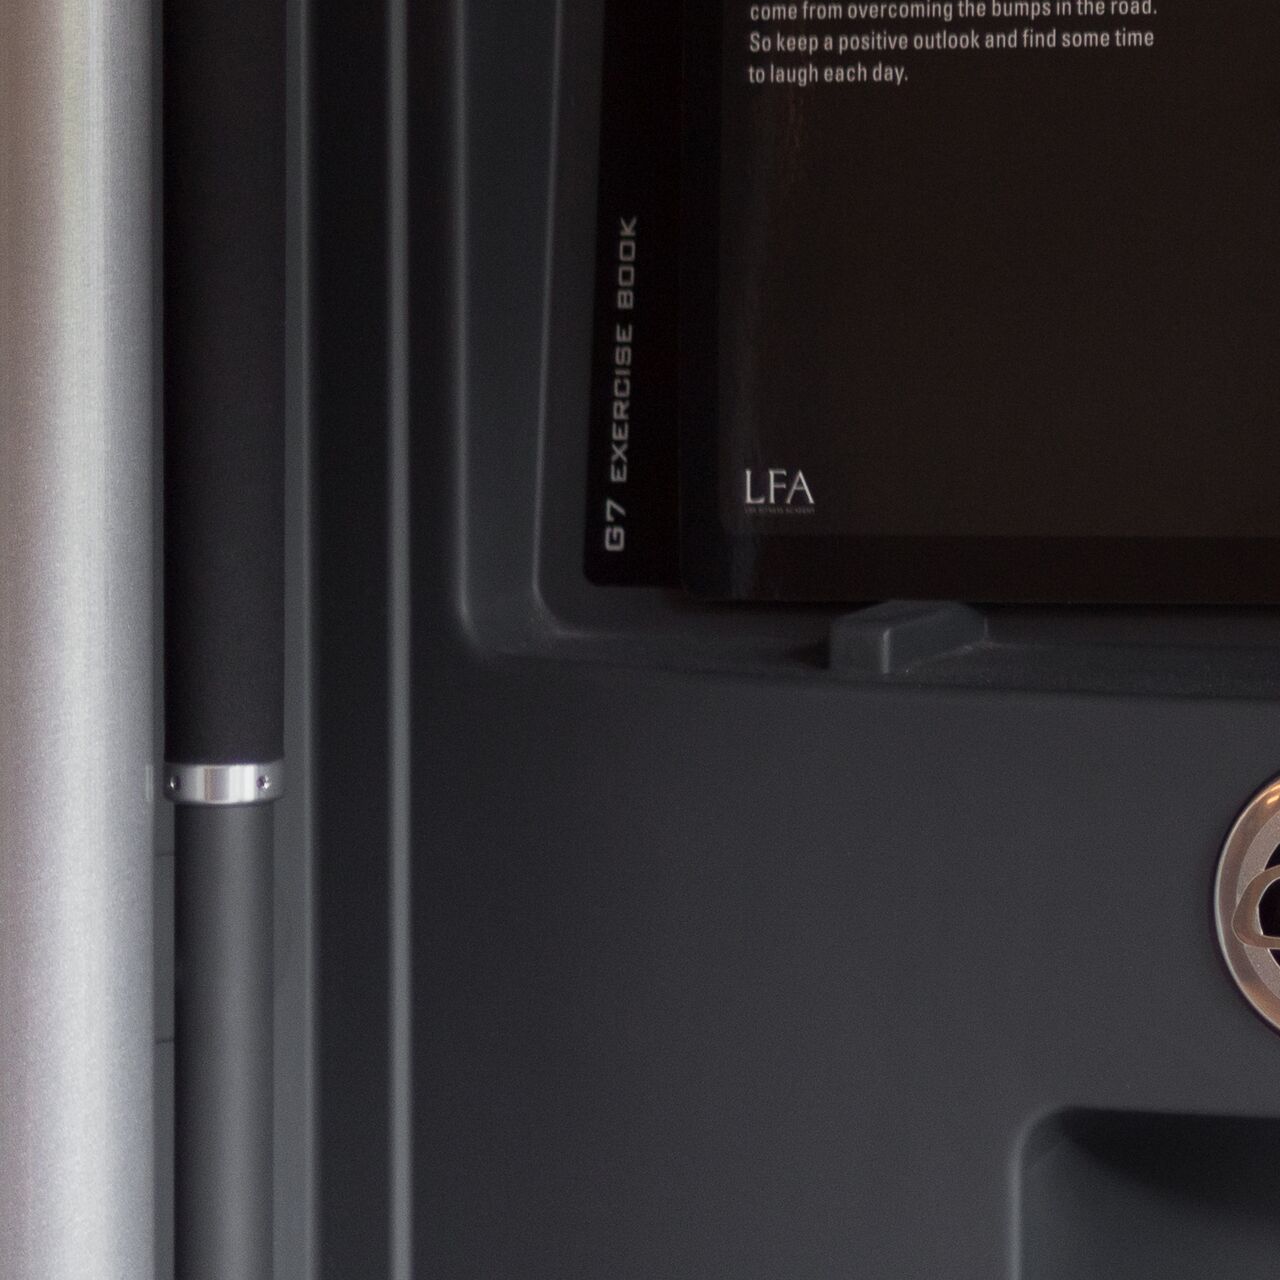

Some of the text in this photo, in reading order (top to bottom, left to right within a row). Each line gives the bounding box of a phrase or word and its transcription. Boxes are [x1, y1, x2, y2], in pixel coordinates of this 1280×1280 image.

[749, 4, 798, 21] come
[802, 0, 843, 20] from
[749, 27, 1155, 55] So keep a positive outlook and find some time
[748, 61, 909, 87] to laugh each day.
[604, 216, 637, 552] G7 EXERCISE BOOK
[744, 468, 816, 505] LFA
